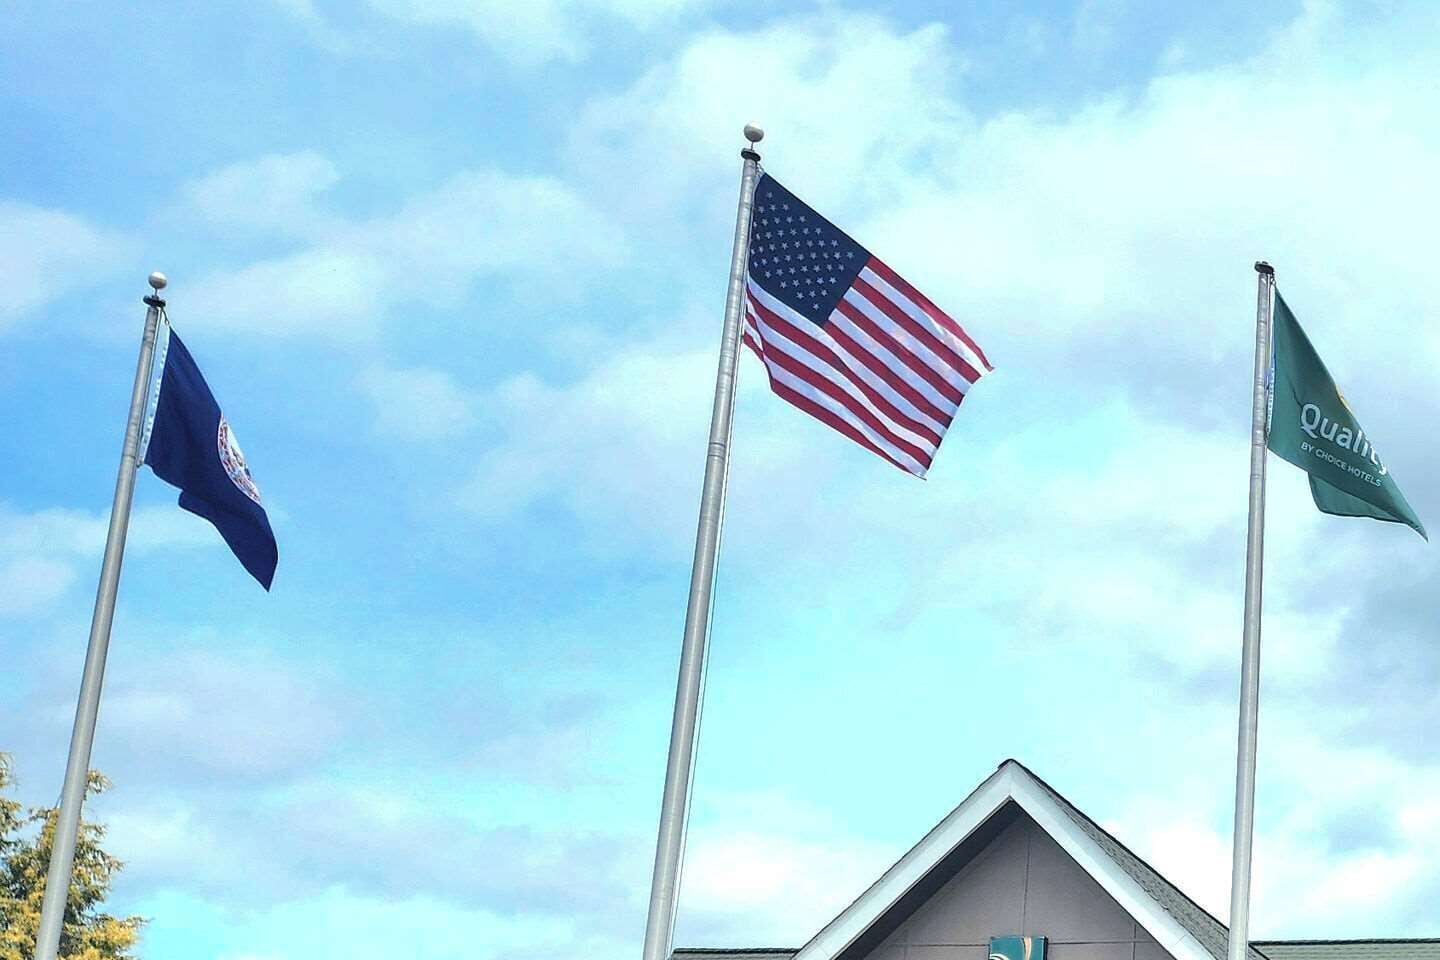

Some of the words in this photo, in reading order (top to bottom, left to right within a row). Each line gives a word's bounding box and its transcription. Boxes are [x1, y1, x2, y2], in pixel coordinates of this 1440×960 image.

[1301, 442, 1314, 453] BY
[1315, 448, 1347, 471] CHOICE
[1347, 465, 1382, 487] HOTELS
